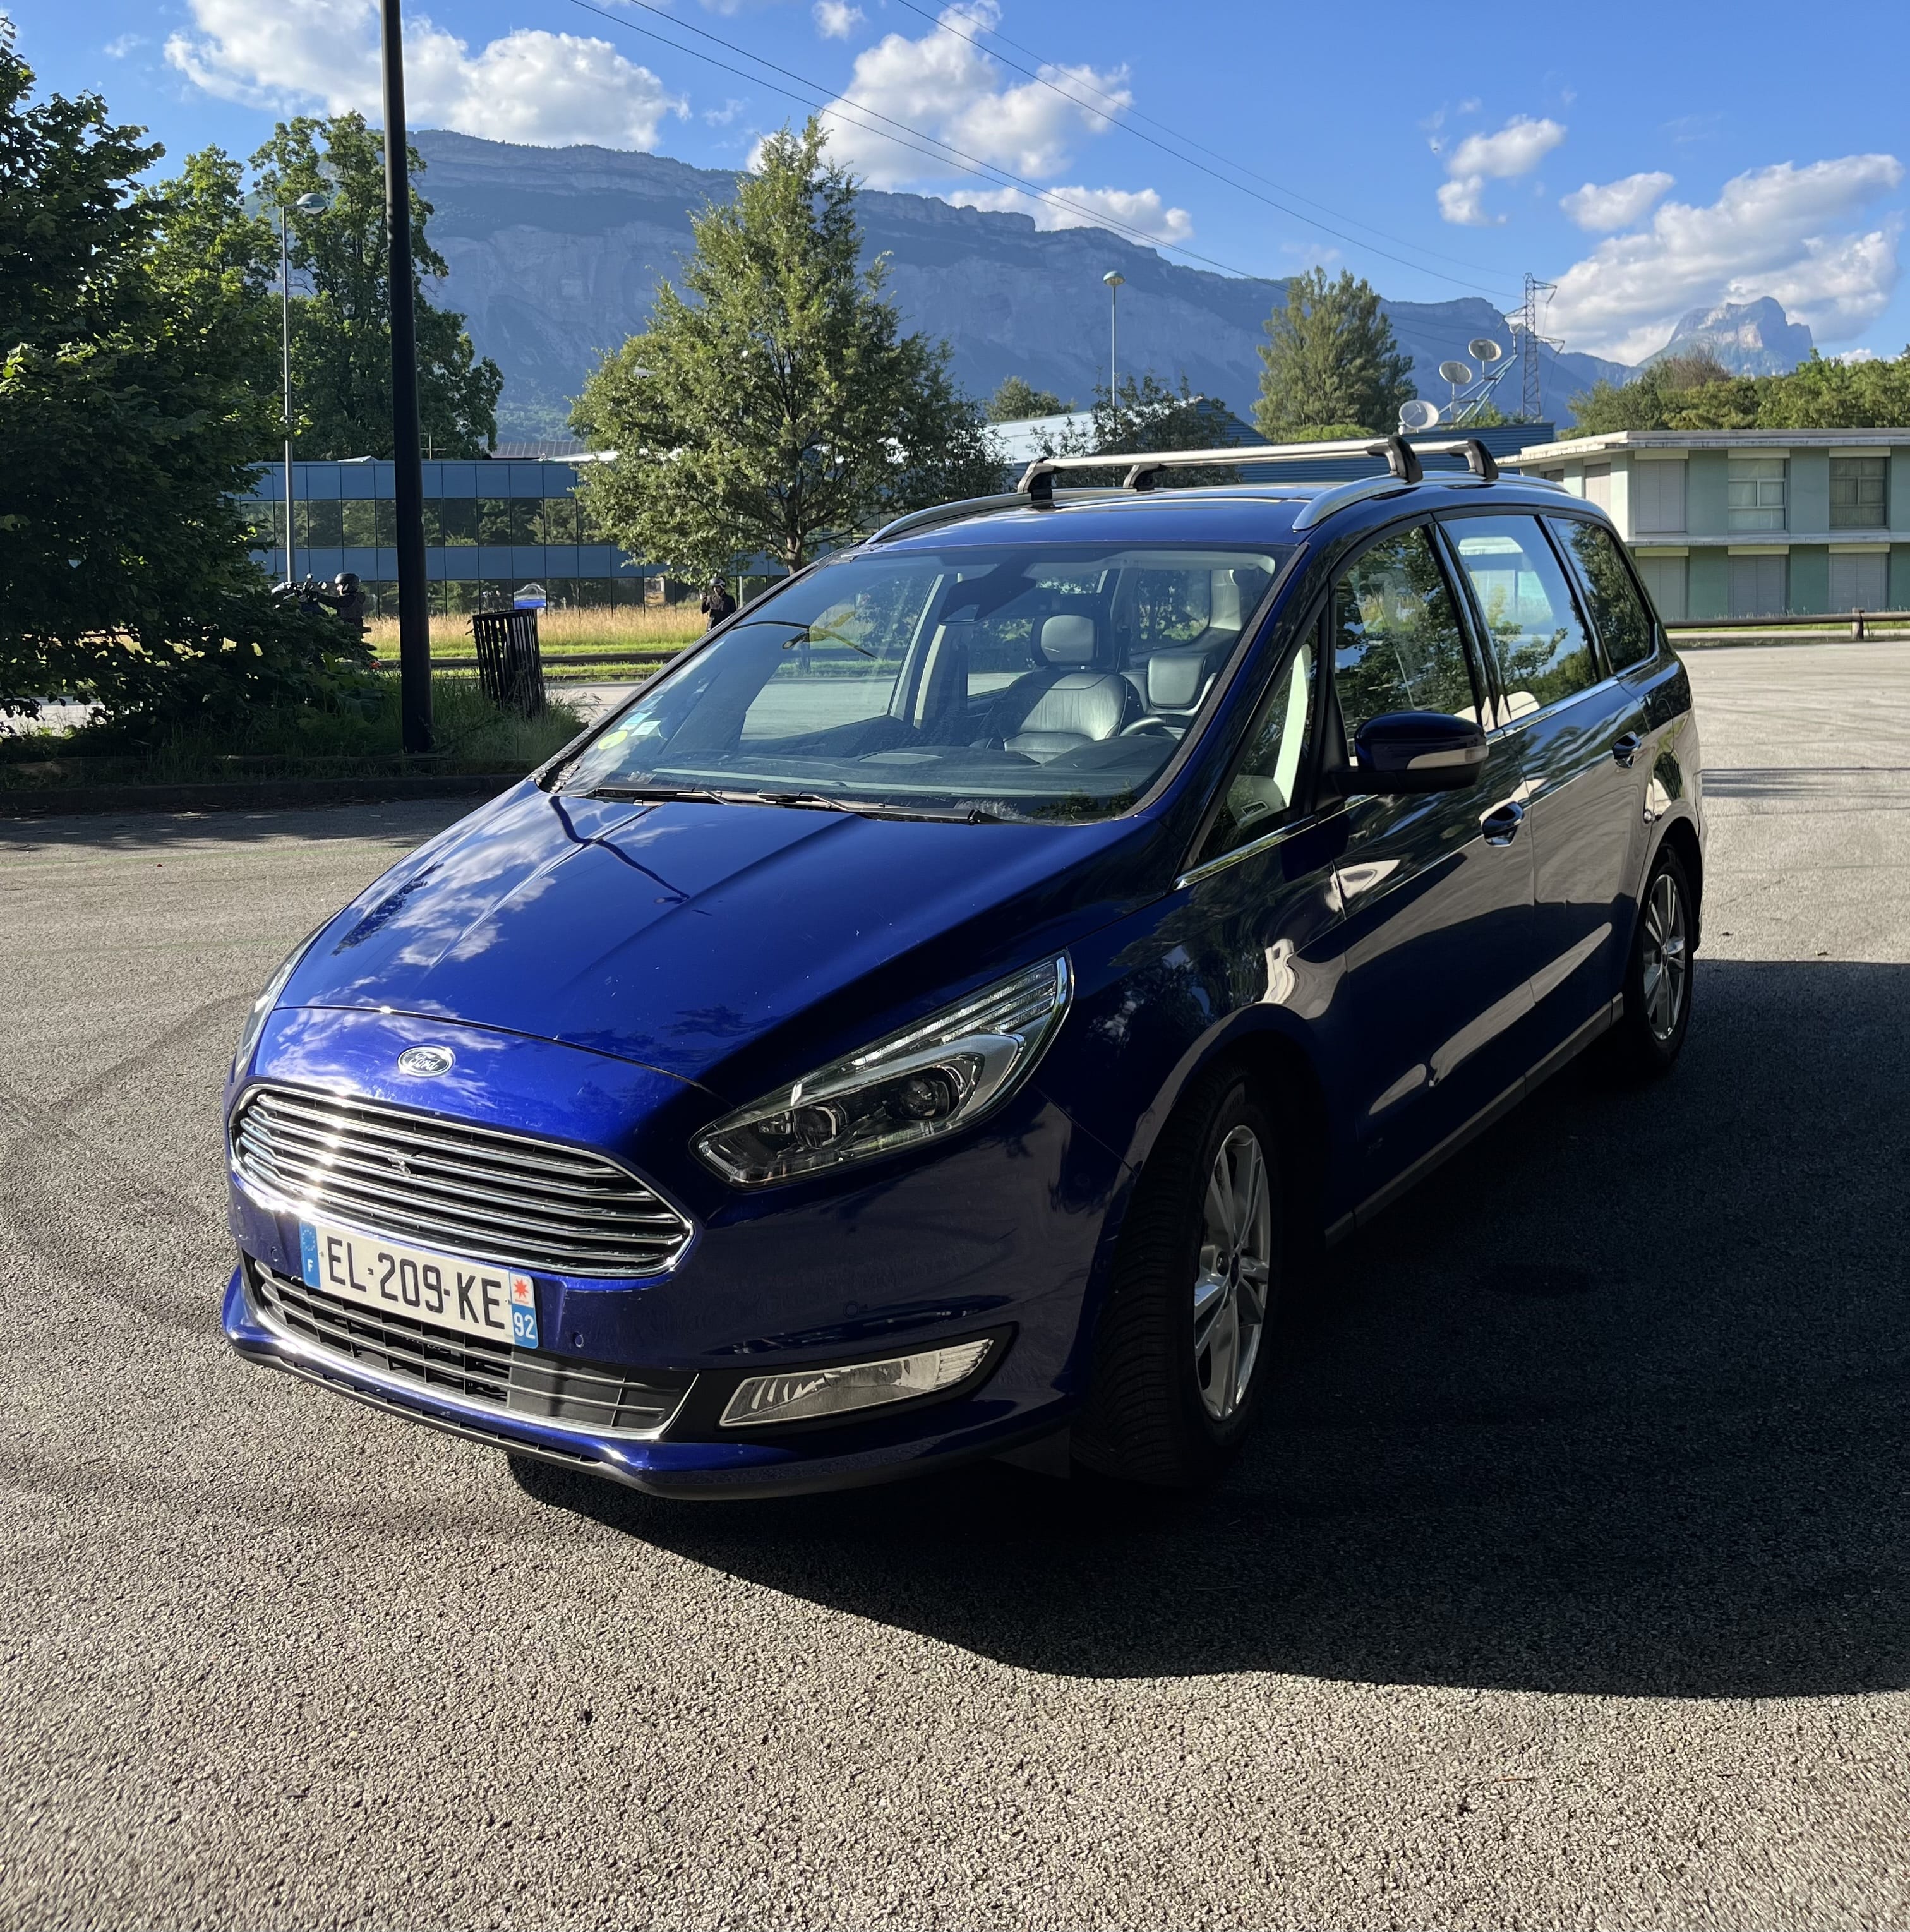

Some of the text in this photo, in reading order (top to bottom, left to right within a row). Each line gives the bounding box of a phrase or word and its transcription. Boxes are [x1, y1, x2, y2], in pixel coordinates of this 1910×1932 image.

[407, 1052, 441, 1071] Ford
[308, 1259, 313, 1272] F
[326, 1235, 505, 1330] EL-209-KE
[514, 1312, 536, 1339] 92
